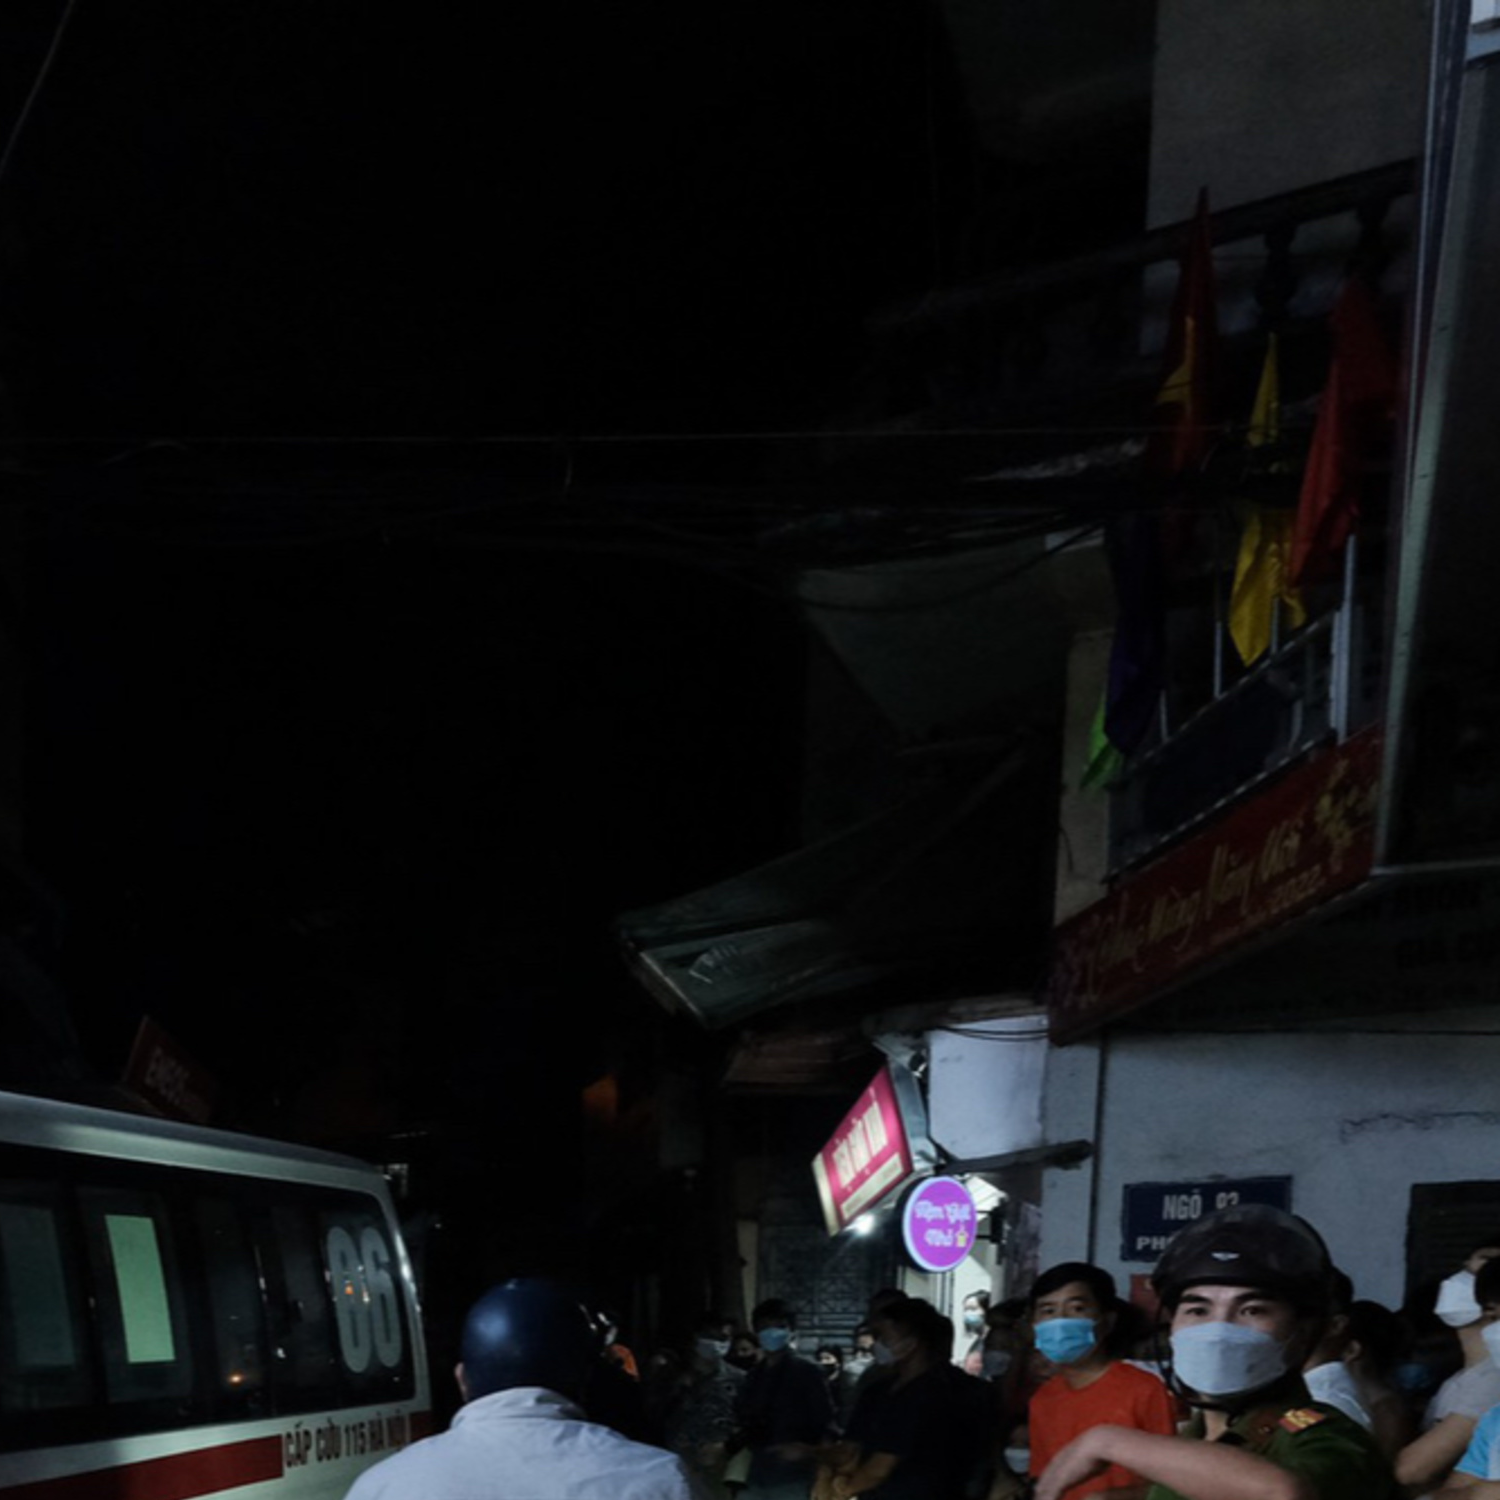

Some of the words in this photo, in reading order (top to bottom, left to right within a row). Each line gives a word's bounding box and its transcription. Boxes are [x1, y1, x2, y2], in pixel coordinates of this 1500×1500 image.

[1162, 1188, 1203, 1221] NGÕ
[286, 1420, 311, 1467] CẤP
[316, 1416, 341, 1461] CỨU
[345, 1422, 366, 1456] 115
